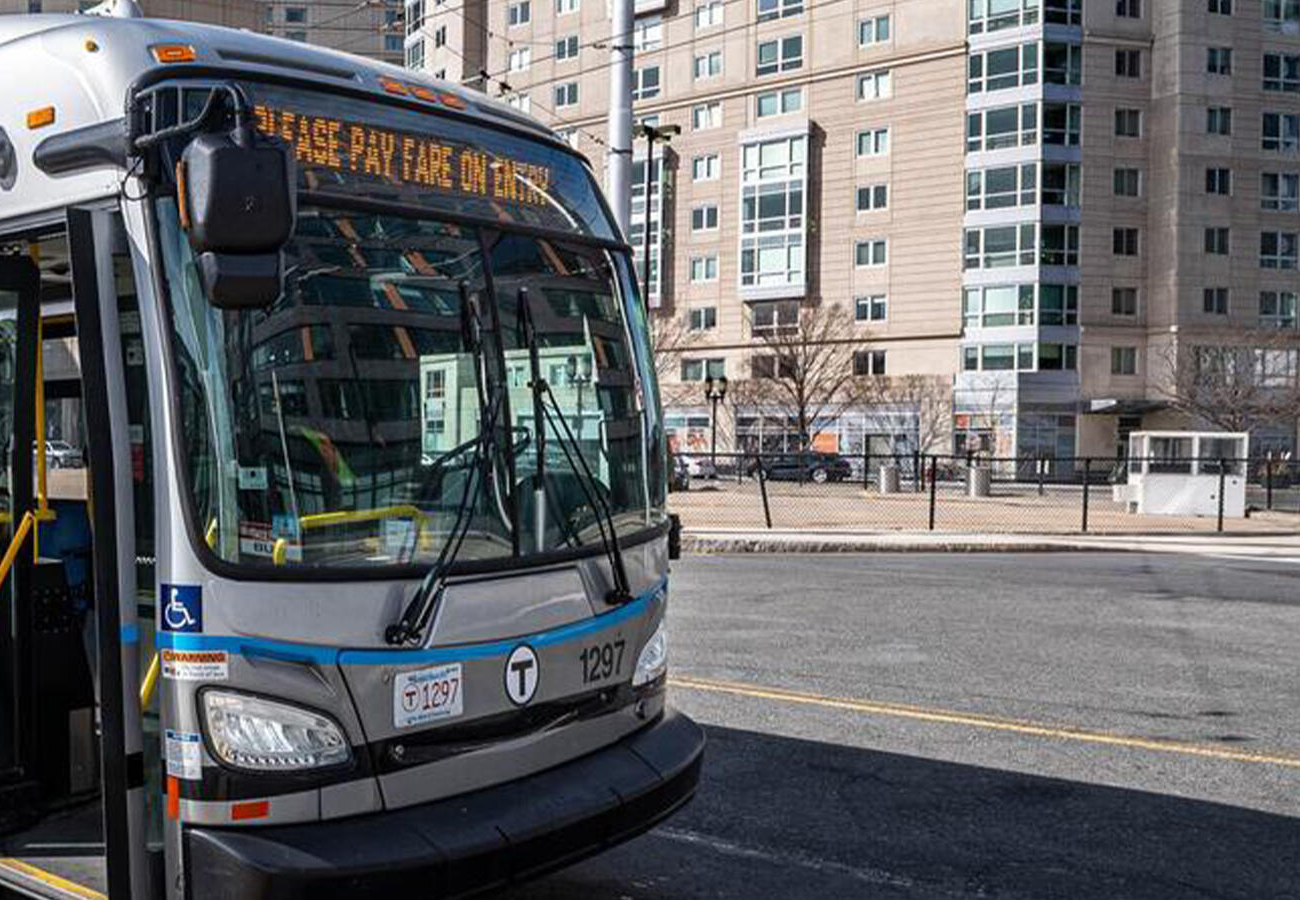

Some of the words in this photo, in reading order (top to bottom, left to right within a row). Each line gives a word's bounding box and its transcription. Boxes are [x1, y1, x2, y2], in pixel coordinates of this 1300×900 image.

[351, 126, 396, 177] PAY
[403, 138, 452, 188] FARE
[461, 149, 487, 194] ON
[494, 159, 549, 205] ENTRY
[511, 660, 533, 696] T
[580, 639, 625, 684] 1297
[423, 679, 458, 710] 1297
